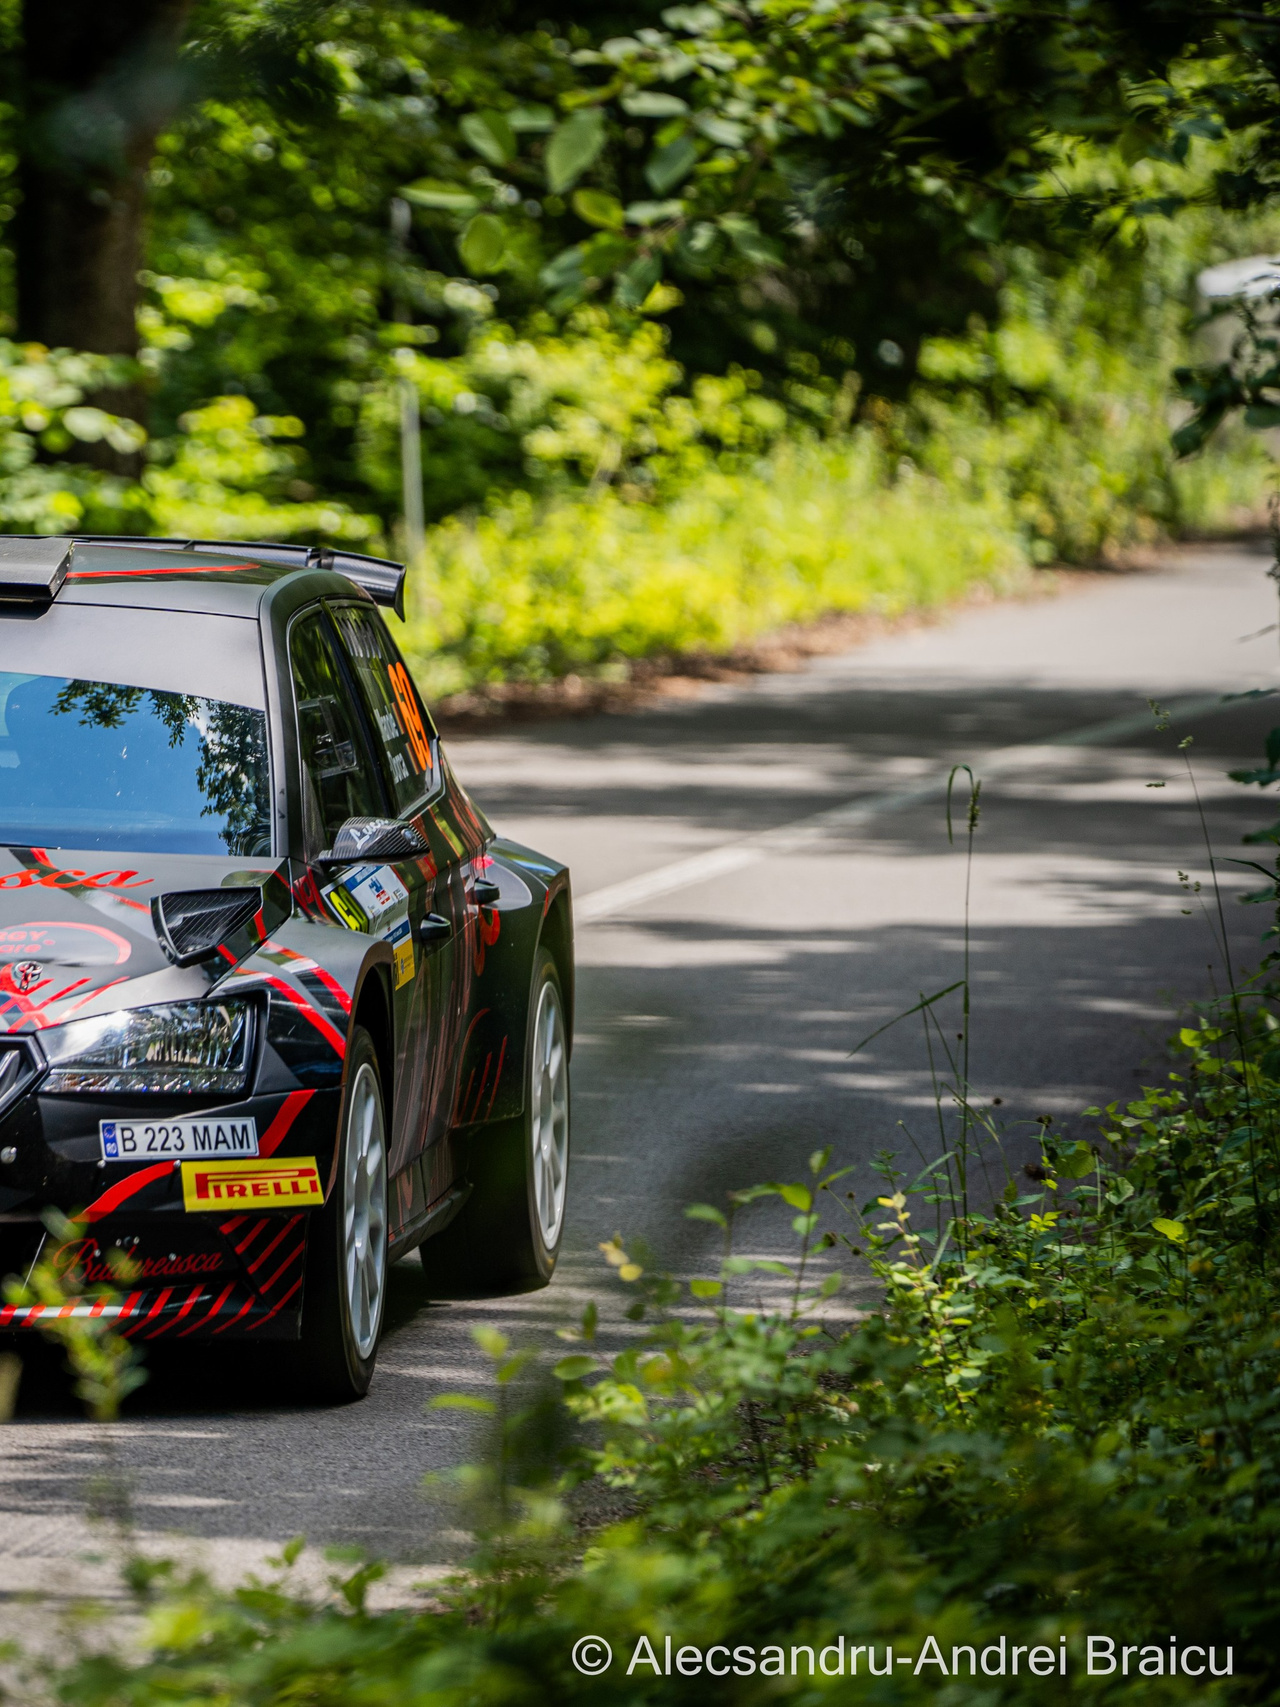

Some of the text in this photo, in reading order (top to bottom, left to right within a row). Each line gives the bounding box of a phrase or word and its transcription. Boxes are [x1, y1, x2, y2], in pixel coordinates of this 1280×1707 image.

[387, 661, 433, 772] 69
[120, 1123, 251, 1152] B 223 MAM
[194, 1168, 320, 1200] PIRELLI
